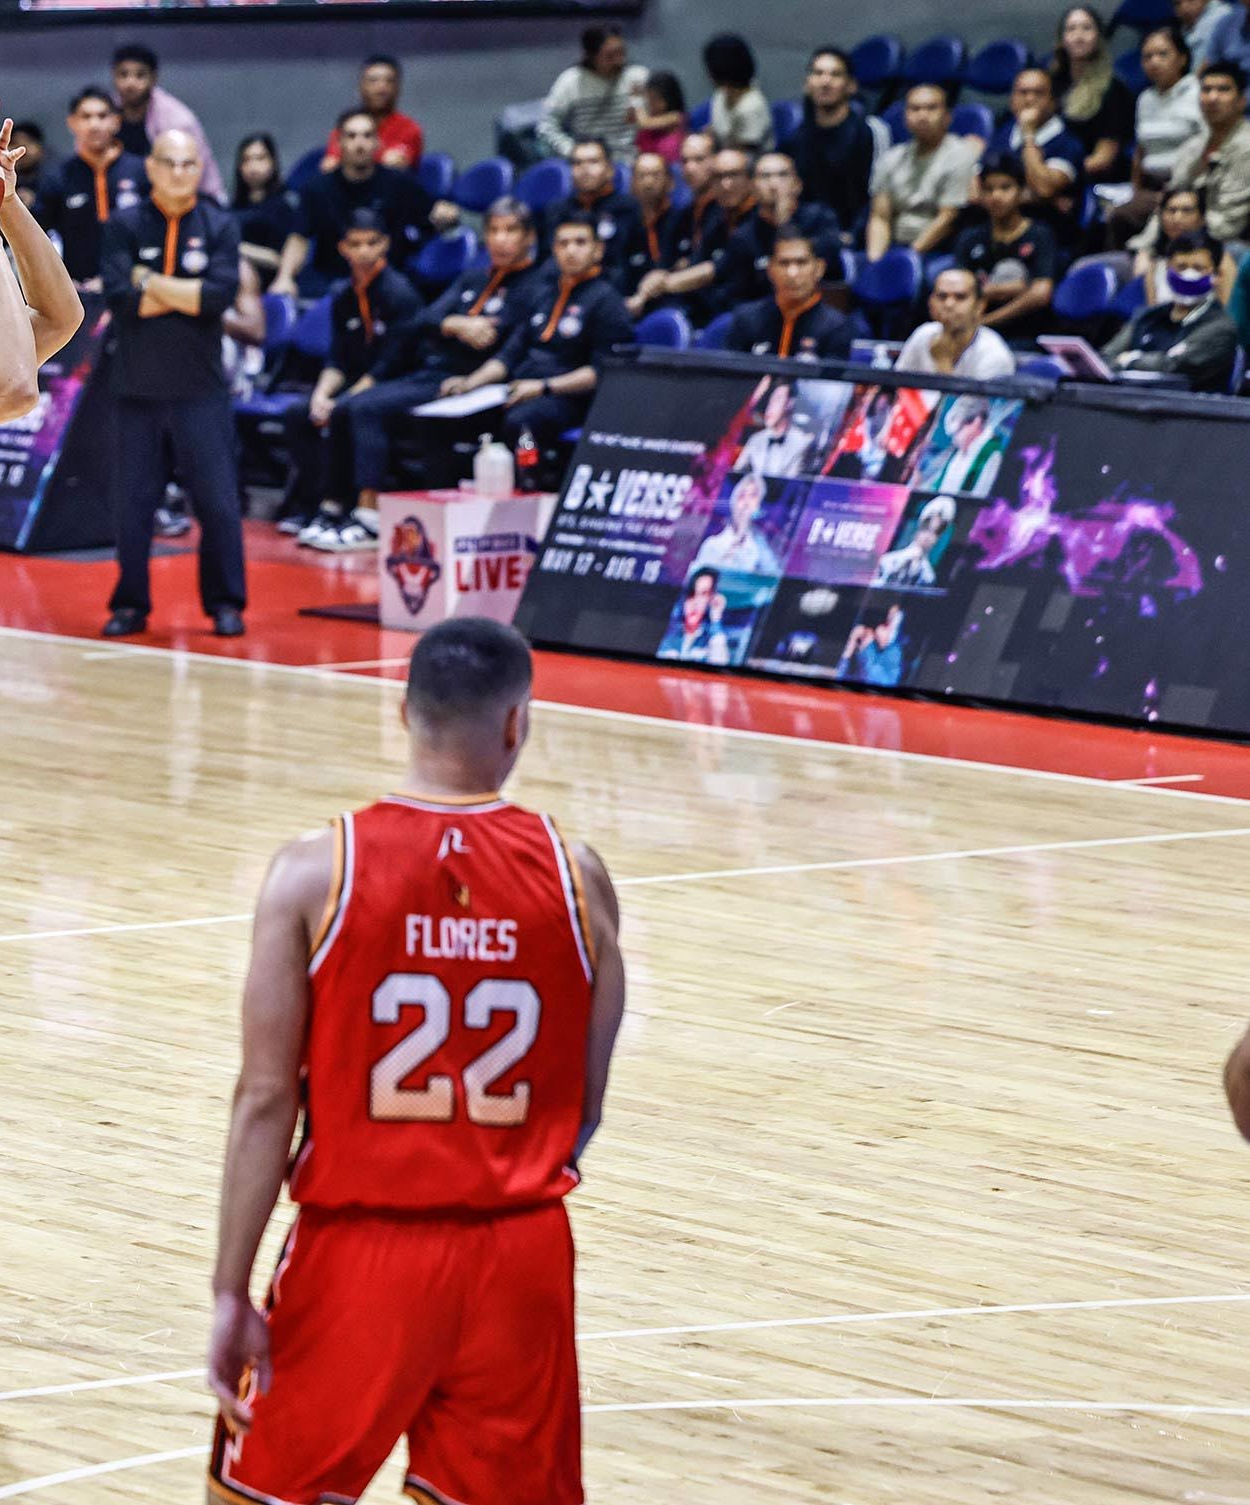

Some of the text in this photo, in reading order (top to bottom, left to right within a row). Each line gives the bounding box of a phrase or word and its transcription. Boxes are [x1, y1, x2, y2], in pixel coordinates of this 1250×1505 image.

[456, 555, 522, 592] LIVE
[405, 912, 518, 962] FLORES
[369, 972, 542, 1126] 22
